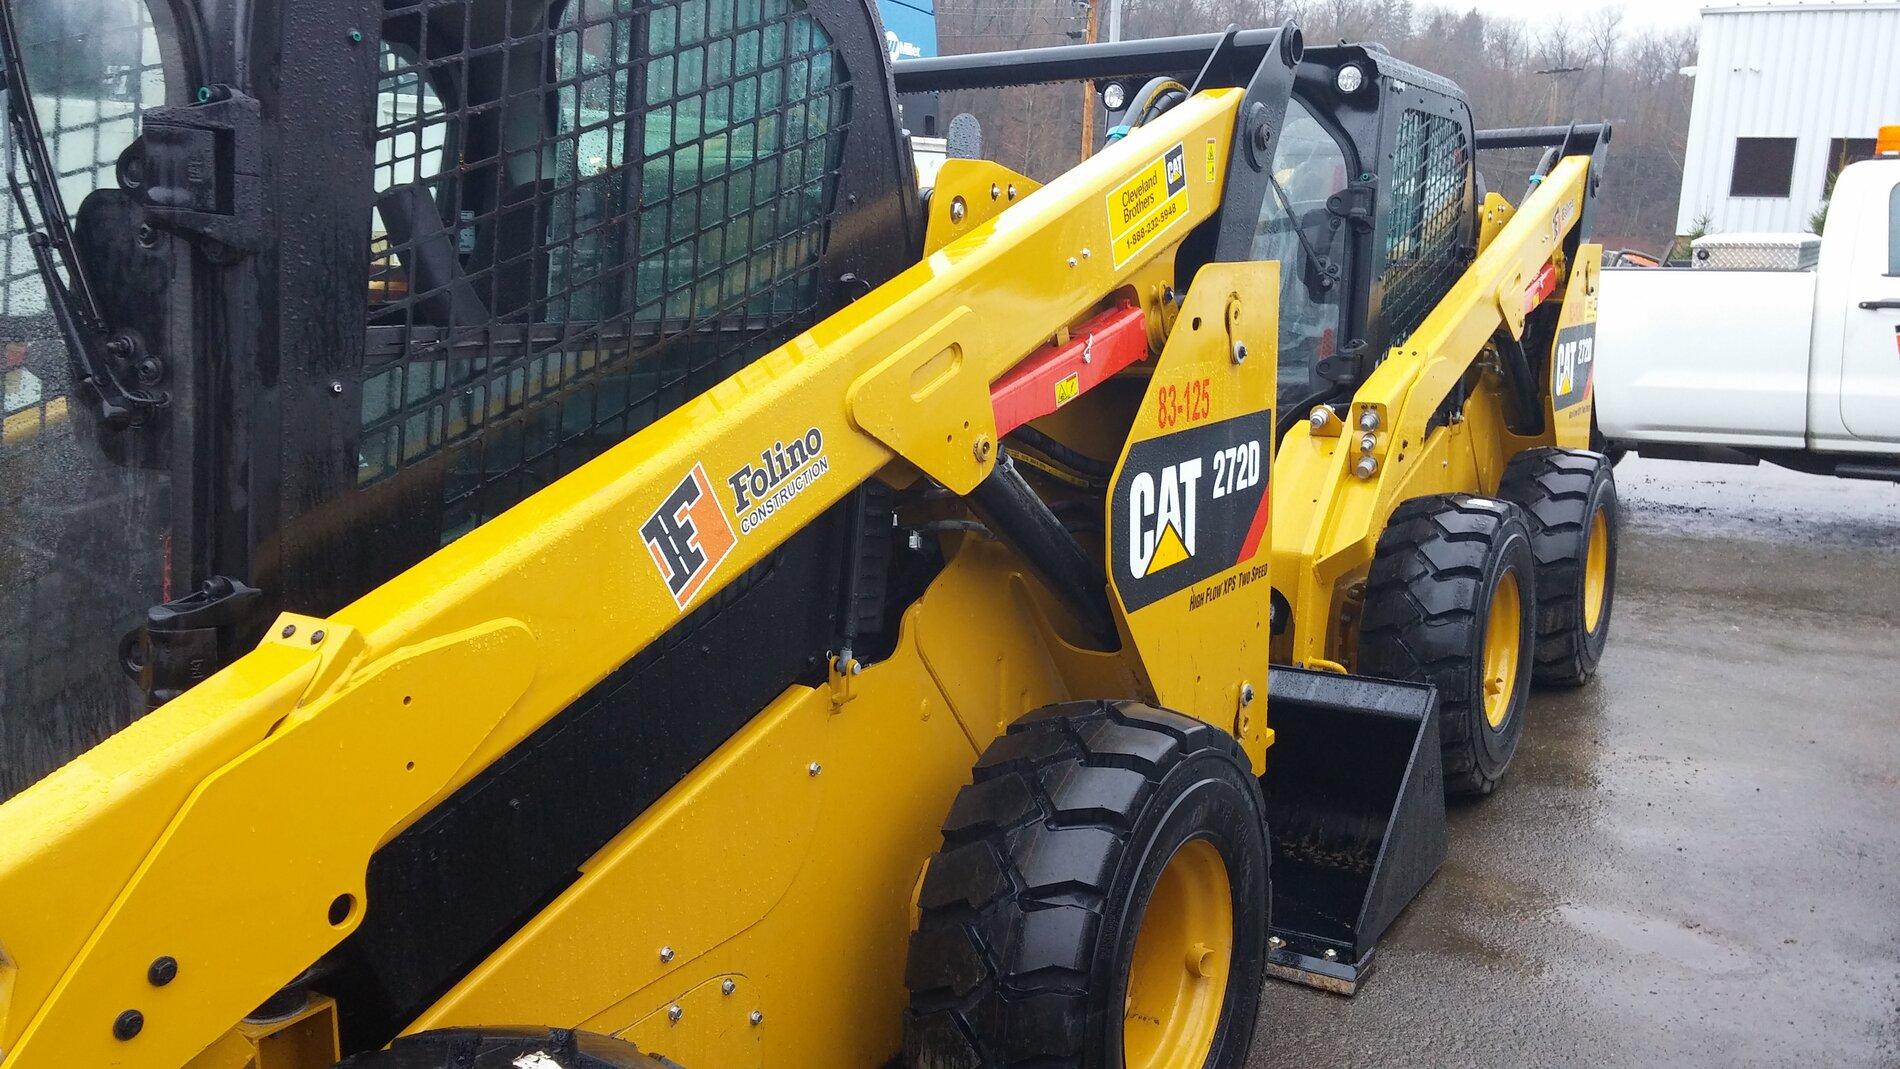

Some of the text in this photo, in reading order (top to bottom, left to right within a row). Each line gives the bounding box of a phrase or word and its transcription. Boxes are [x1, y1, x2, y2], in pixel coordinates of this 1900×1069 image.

[1122, 170, 1158, 208] Cleveland
[1167, 154, 1182, 184] CAT
[1123, 192, 1155, 224] Brothers
[1126, 203, 1177, 250] 1-888-232-5948
[1556, 341, 1577, 396] CAT
[1157, 378, 1210, 429] 83-125
[728, 427, 823, 515] Folino
[741, 457, 828, 533] CONSTRUCTION
[1212, 439, 1260, 500] 272D
[1129, 457, 1202, 580] CAT
[1222, 575, 1237, 595] XPS
